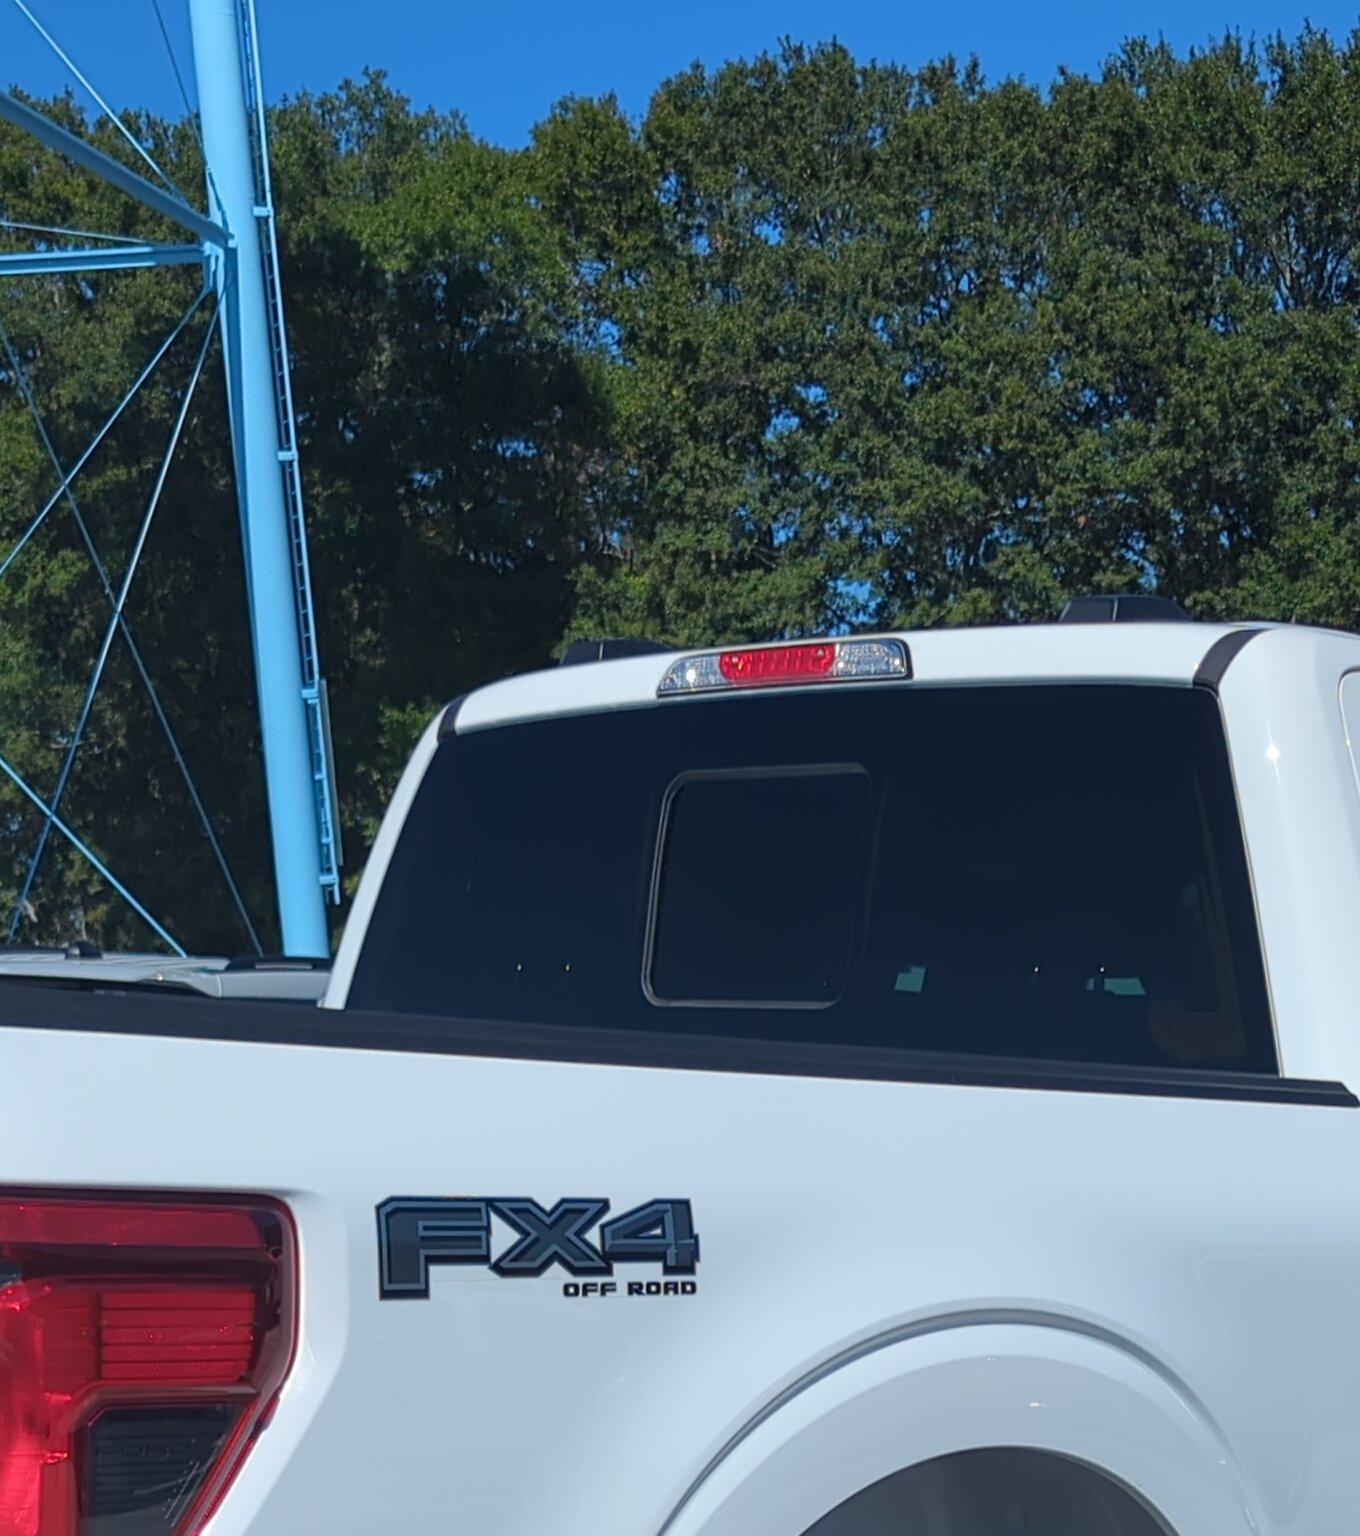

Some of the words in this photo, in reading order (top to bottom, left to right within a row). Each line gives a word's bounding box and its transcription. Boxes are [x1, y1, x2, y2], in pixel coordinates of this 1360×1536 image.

[375, 1196, 700, 1301] FX4
[563, 1281, 617, 1297] OFF
[627, 1281, 697, 1296] ROAD
